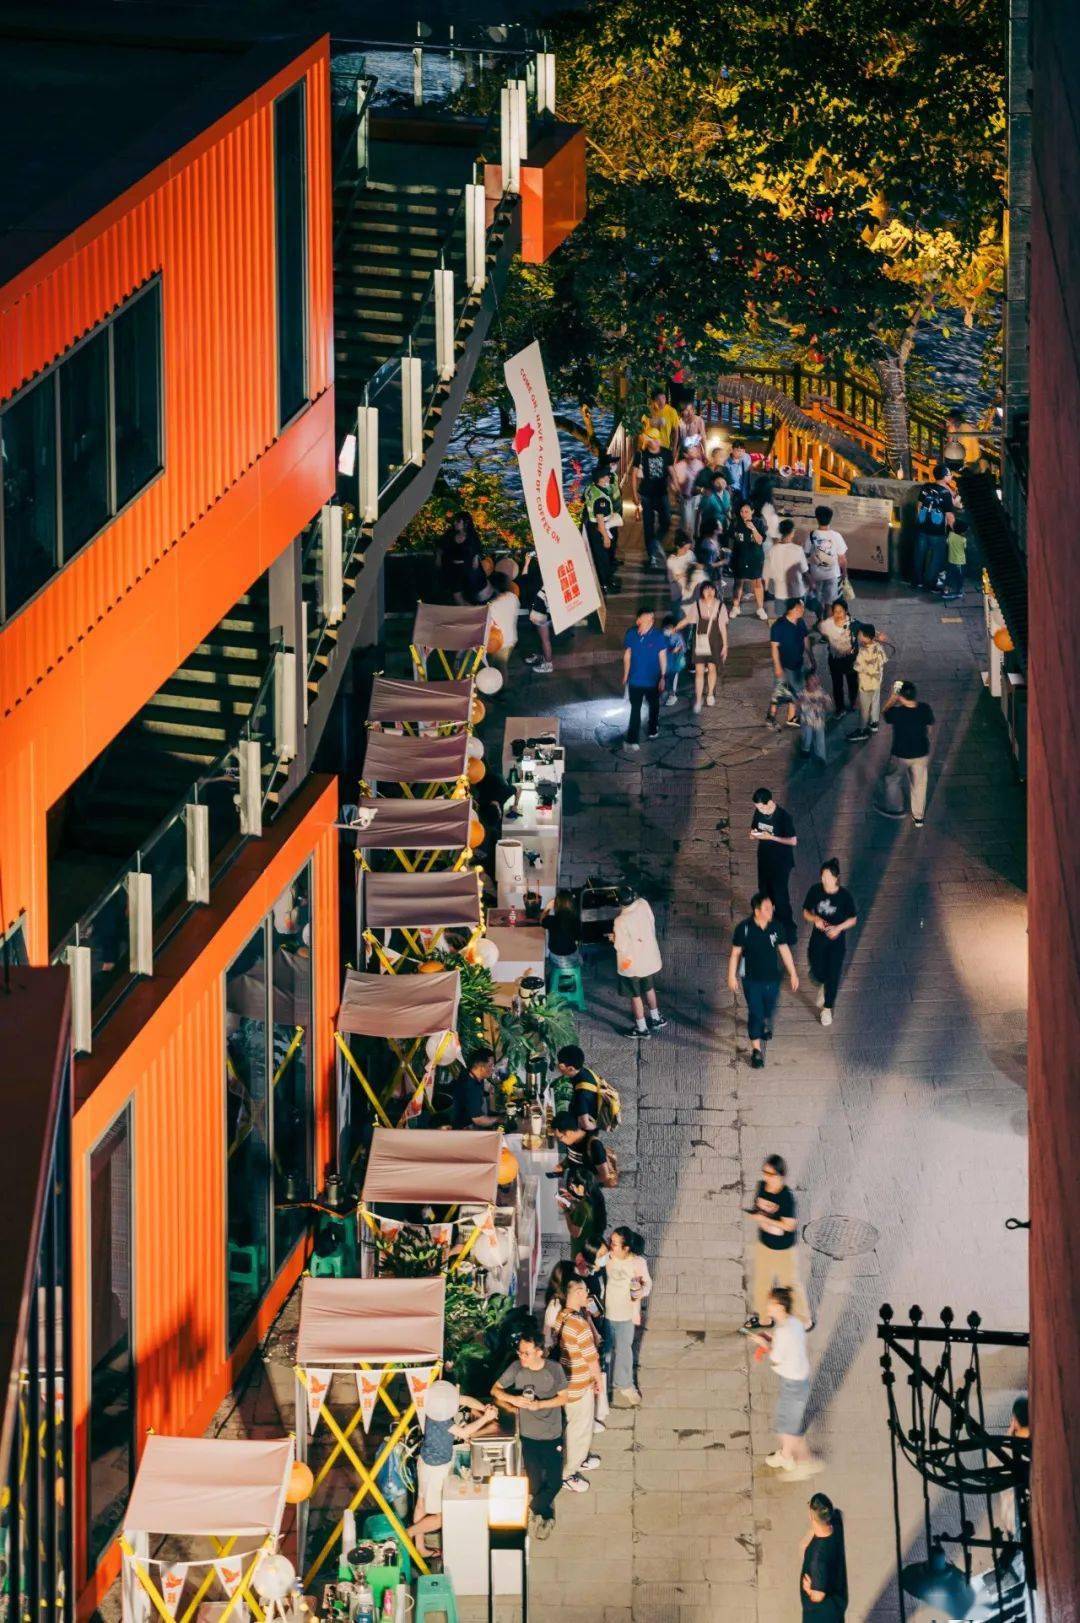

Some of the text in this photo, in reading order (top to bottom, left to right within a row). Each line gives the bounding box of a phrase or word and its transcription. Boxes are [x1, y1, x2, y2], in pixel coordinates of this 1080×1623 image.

[538, 445, 543, 453] A
[536, 455, 544, 478] CUP
[535, 479, 541, 493] OF
[536, 496, 551, 534] COFFEE
[551, 531, 561, 544] ON
